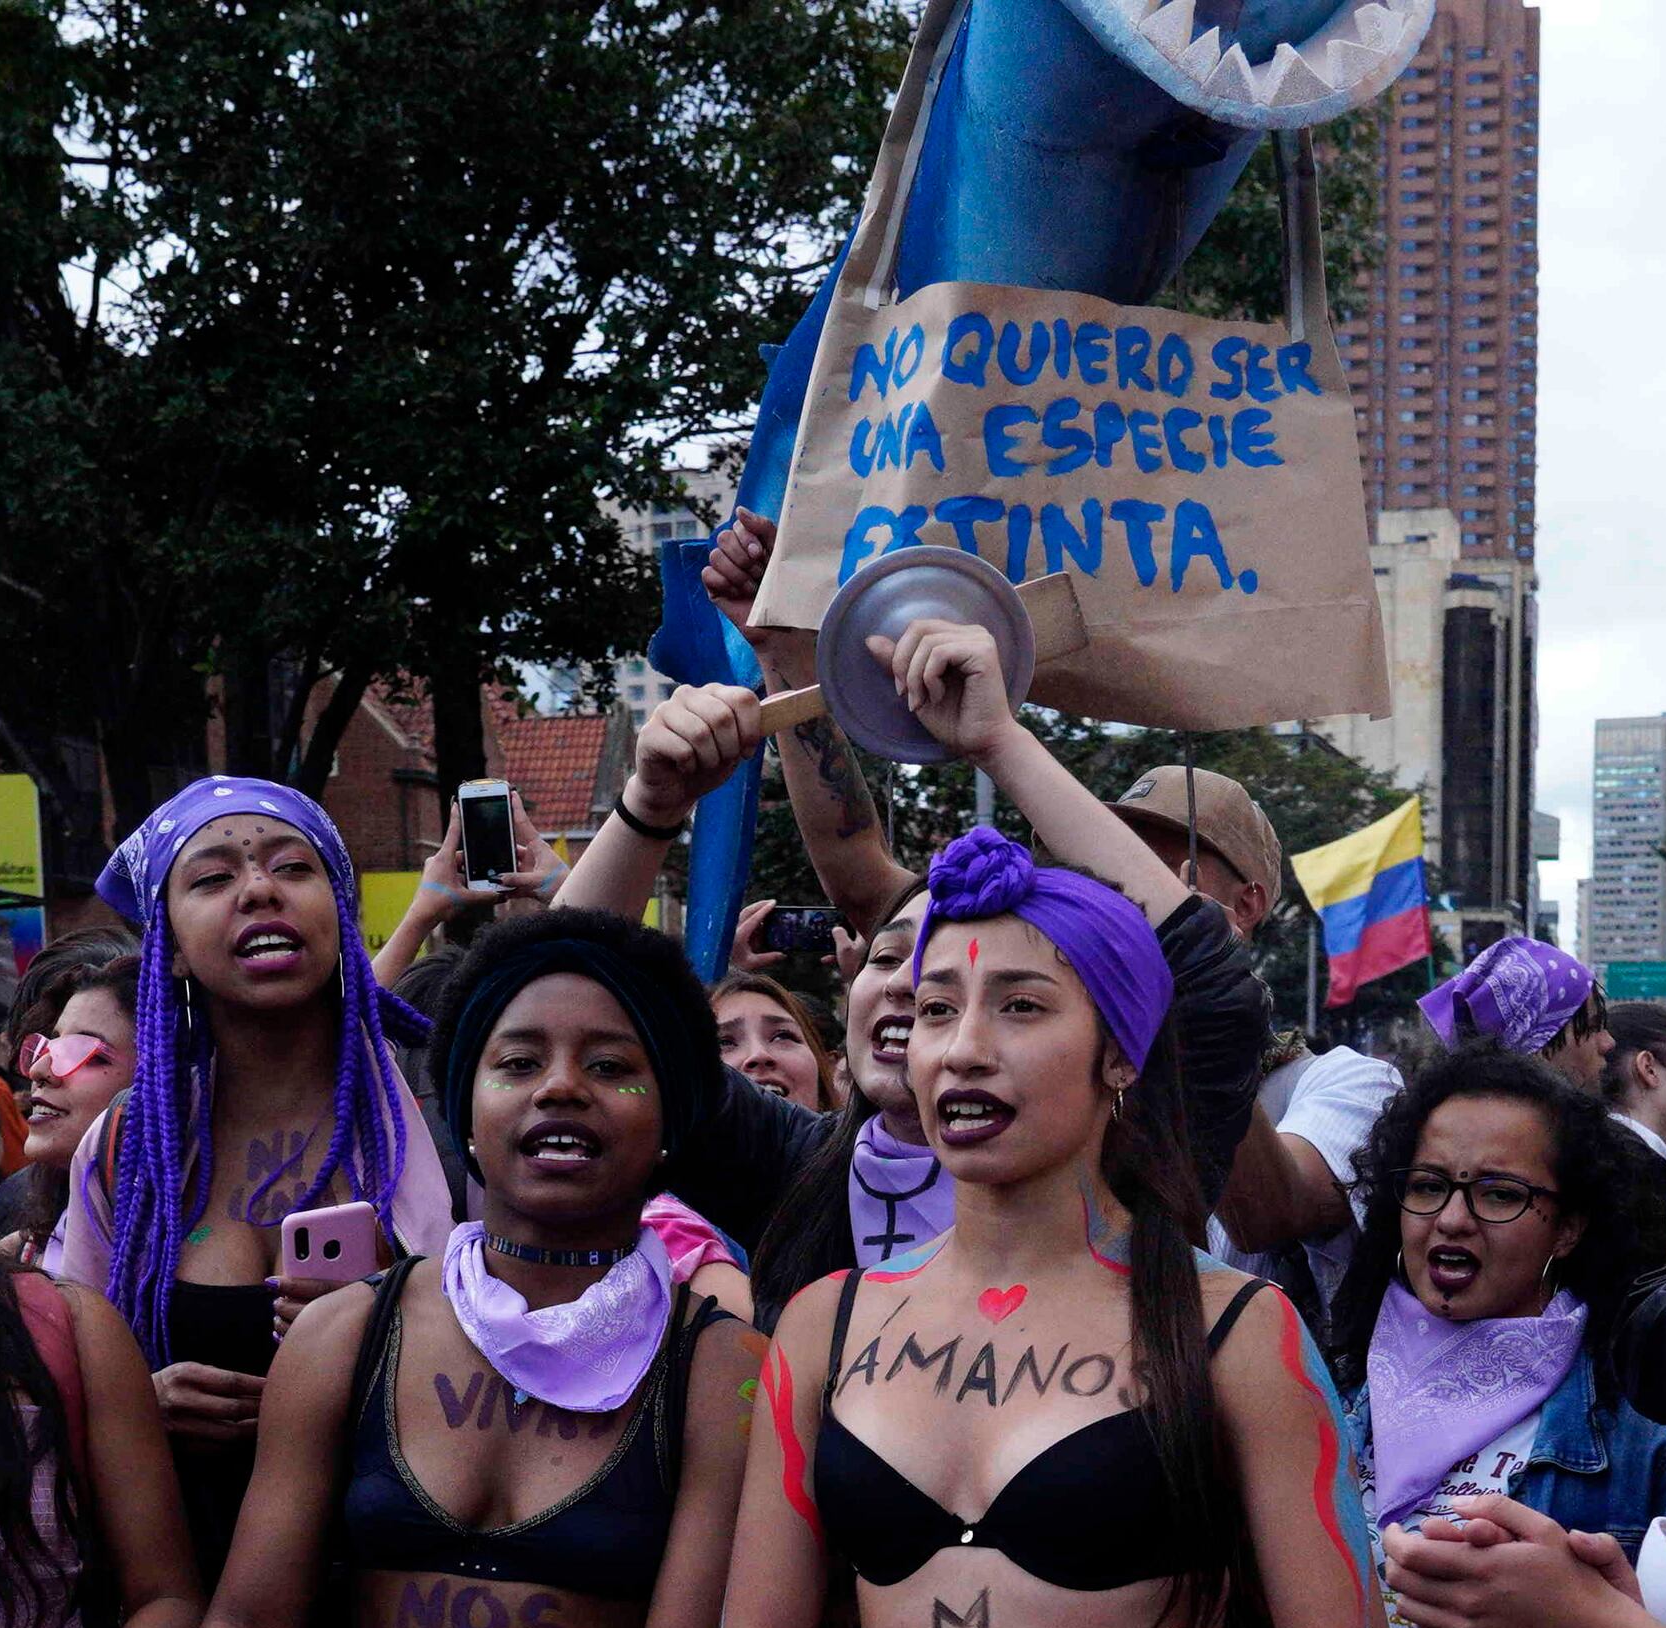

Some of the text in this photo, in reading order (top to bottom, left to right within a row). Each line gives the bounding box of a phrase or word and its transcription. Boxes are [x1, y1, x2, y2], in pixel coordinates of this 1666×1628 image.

[848, 310, 1323, 402] NO QUIERO SER
[849, 396, 1285, 479] UNA ESPECIE
